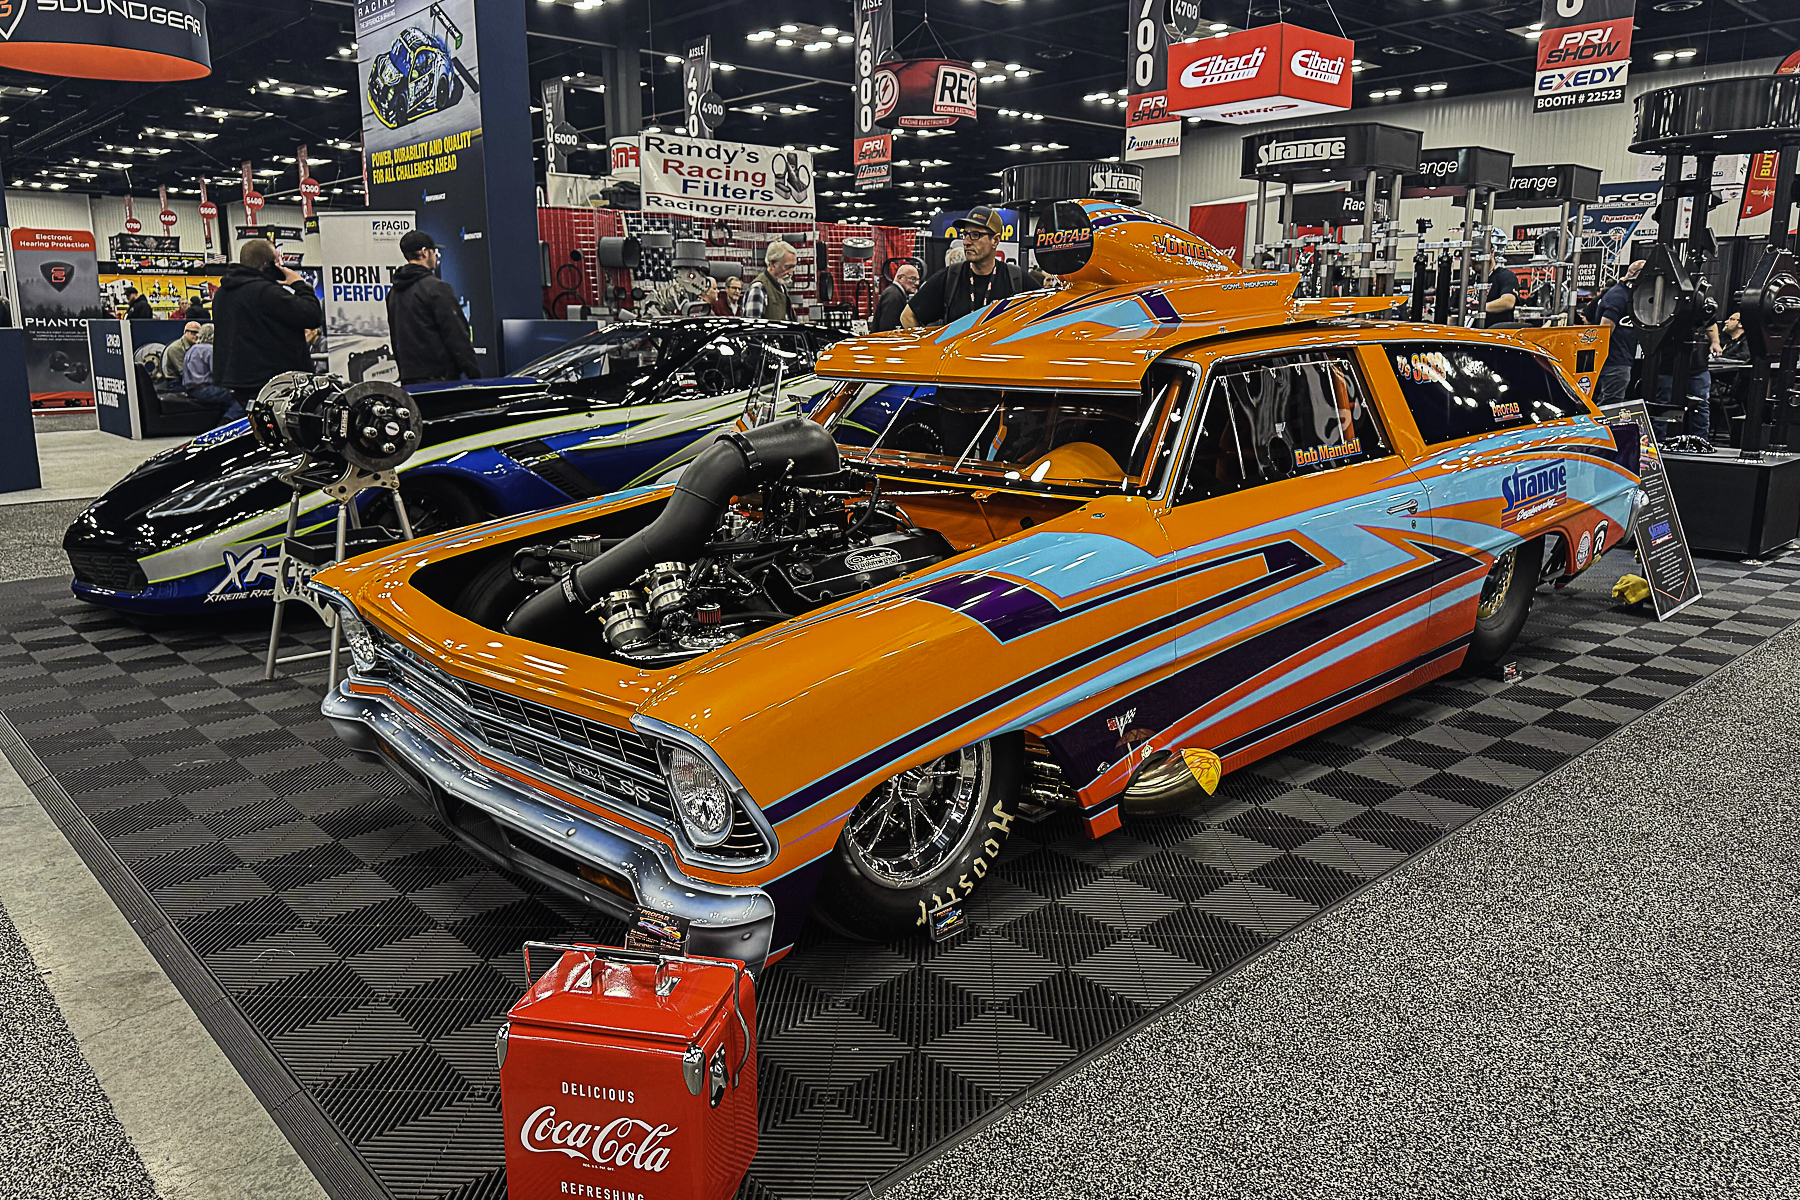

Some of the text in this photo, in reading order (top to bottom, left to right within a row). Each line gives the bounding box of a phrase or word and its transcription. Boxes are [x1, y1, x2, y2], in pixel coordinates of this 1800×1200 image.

[1175, 0, 1198, 20] 4700
[1558, 26, 1613, 49] PRI
[688, 45, 705, 59] AISLE
[1546, 40, 1621, 65] SHOW
[859, 21, 873, 133] 4800
[1180, 46, 1267, 88] Eibach
[1290, 49, 1346, 85] Eibach
[1538, 65, 1626, 91] EXEDY
[702, 102, 724, 116] 4900
[1537, 89, 1622, 109] BOOTH # 22523
[394, 142, 428, 164] DURABILITY
[429, 139, 442, 157] AND
[444, 130, 471, 153] QUALITY
[554, 132, 578, 146] 5000
[645, 136, 760, 165] Randy's
[862, 139, 883, 150] PRI
[858, 148, 888, 161] SHOW
[1257, 137, 1345, 167] Strange
[373, 154, 457, 184] FOR ALL CHALLENGES AHEAD
[663, 158, 767, 188] Racing
[682, 178, 774, 202] Filters
[646, 195, 814, 220] RacingFilter.com
[382, 221, 410, 231] PAGID
[1036, 228, 1091, 247] PROFAB
[332, 266, 398, 284] BORN T
[1294, 437, 1361, 467] Bob Mandell
[1501, 458, 1566, 514] Strange
[204, 588, 250, 604] XTREME
[620, 779, 650, 802] SS
[561, 1081, 635, 1104] DELICIOUS
[520, 1105, 678, 1173] Coca-Cola
[561, 1181, 645, 1200] REFRESHING
